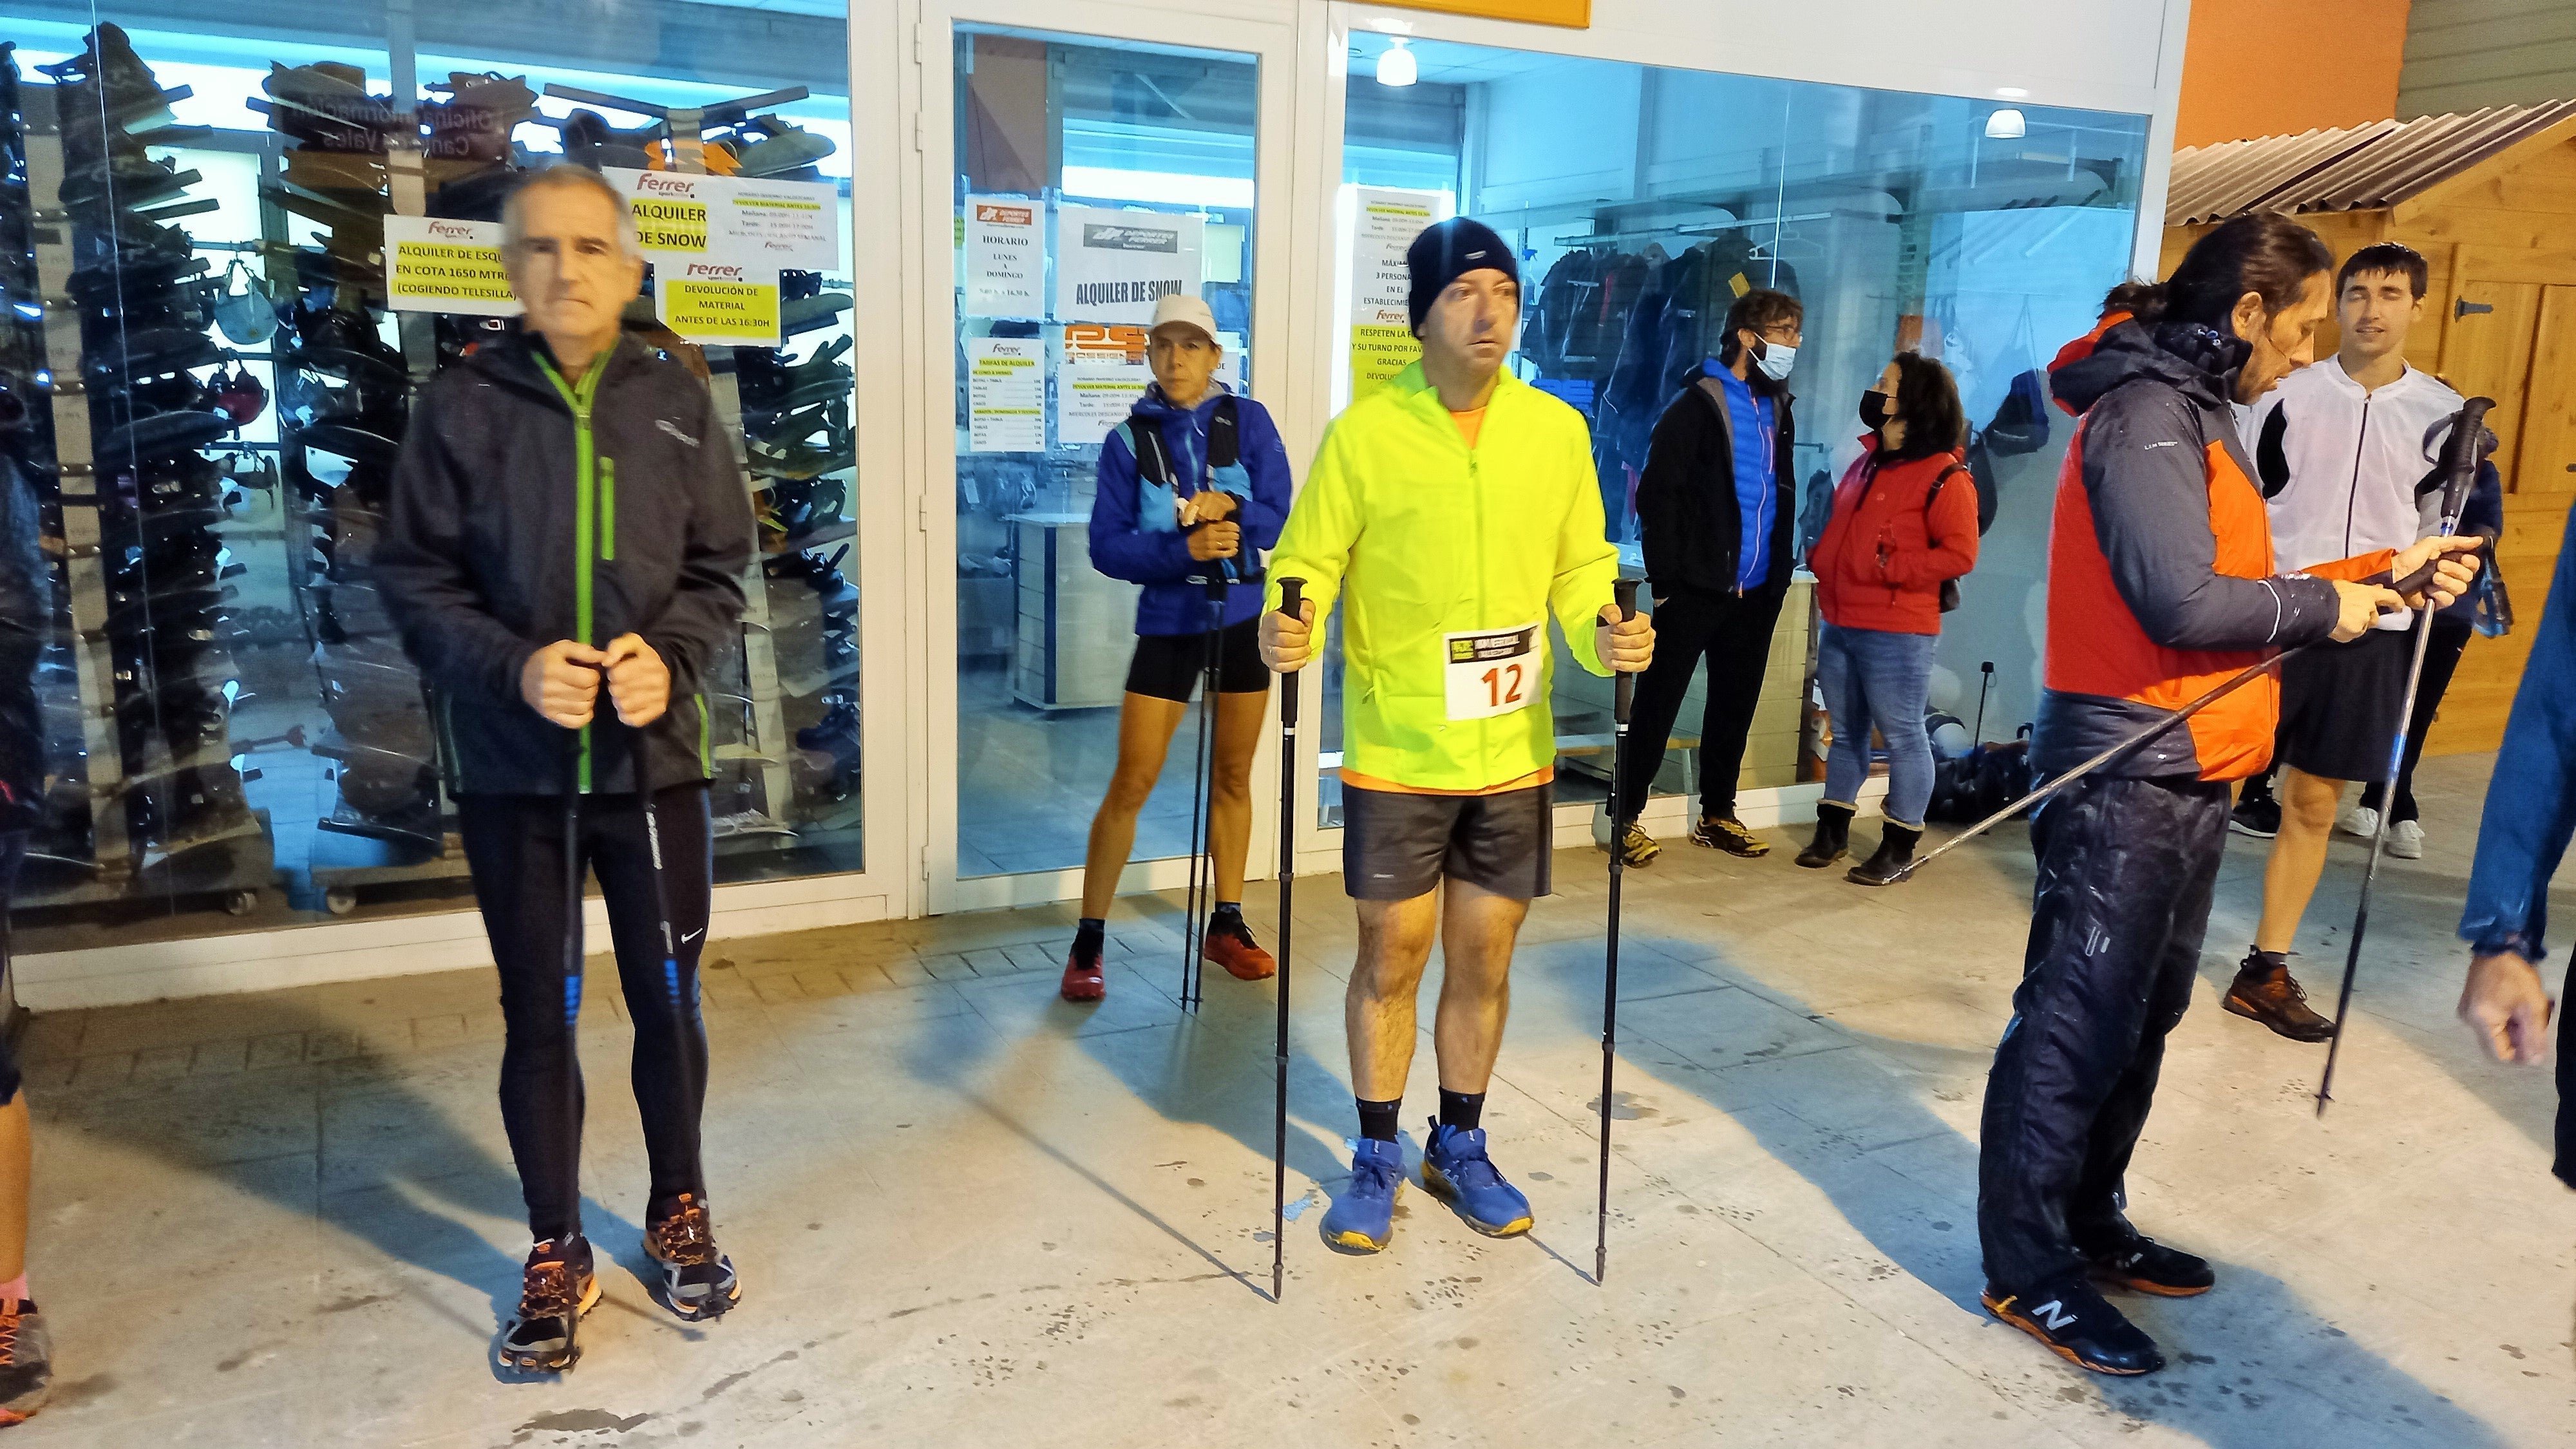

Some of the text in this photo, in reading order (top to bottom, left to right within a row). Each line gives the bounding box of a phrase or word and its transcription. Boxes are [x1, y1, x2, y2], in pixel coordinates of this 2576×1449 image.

[637, 173, 694, 192] Ferrer
[632, 204, 706, 222] ALQUILER
[658, 232, 706, 248] SNOW
[983, 235, 1028, 245] HORARIO
[399, 245, 454, 258] ALQUILER
[458, 251, 471, 259] DE
[396, 264, 509, 281] EN COTA 1650 MTR
[397, 283, 516, 301] (COGIENDO TELESILLA)
[685, 285, 743, 296] DEVOLUCIÓN
[1076, 279, 1182, 306] ALQUILER DE SNOW
[699, 301, 744, 310] MATERIAL
[1364, 297, 1408, 305] ESTABLECIMIE
[675, 316, 703, 324] ANTES
[1376, 309, 1404, 319] Ferrer
[1360, 328, 1395, 337] RESPETEN
[992, 343, 1021, 353] Ferrer
[1481, 664, 1522, 706] 12
